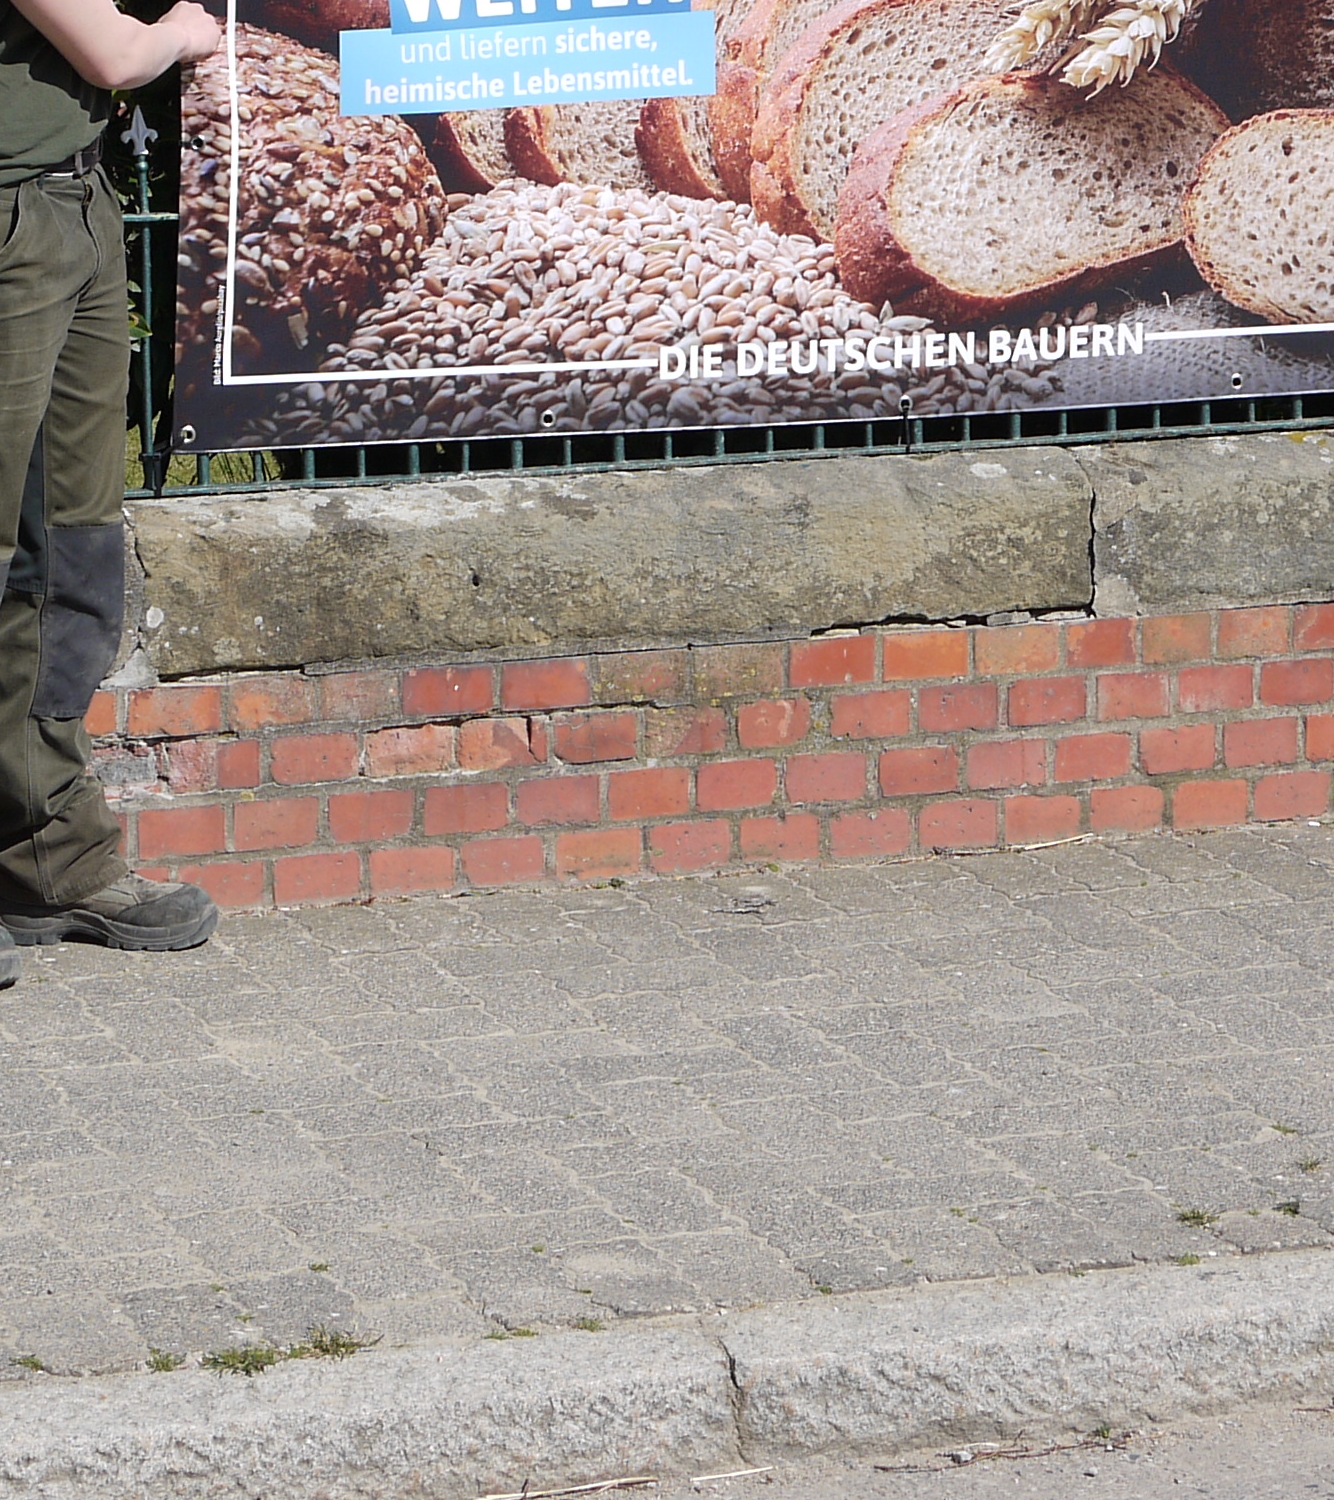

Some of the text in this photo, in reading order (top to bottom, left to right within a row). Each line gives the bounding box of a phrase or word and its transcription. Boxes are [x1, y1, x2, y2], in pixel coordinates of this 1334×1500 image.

[400, 27, 658, 64] und liefern sichere,
[365, 60, 694, 105] heimische Lebensmittel.
[659, 322, 1144, 380] DIE DEUTSCHEN BAUERN
